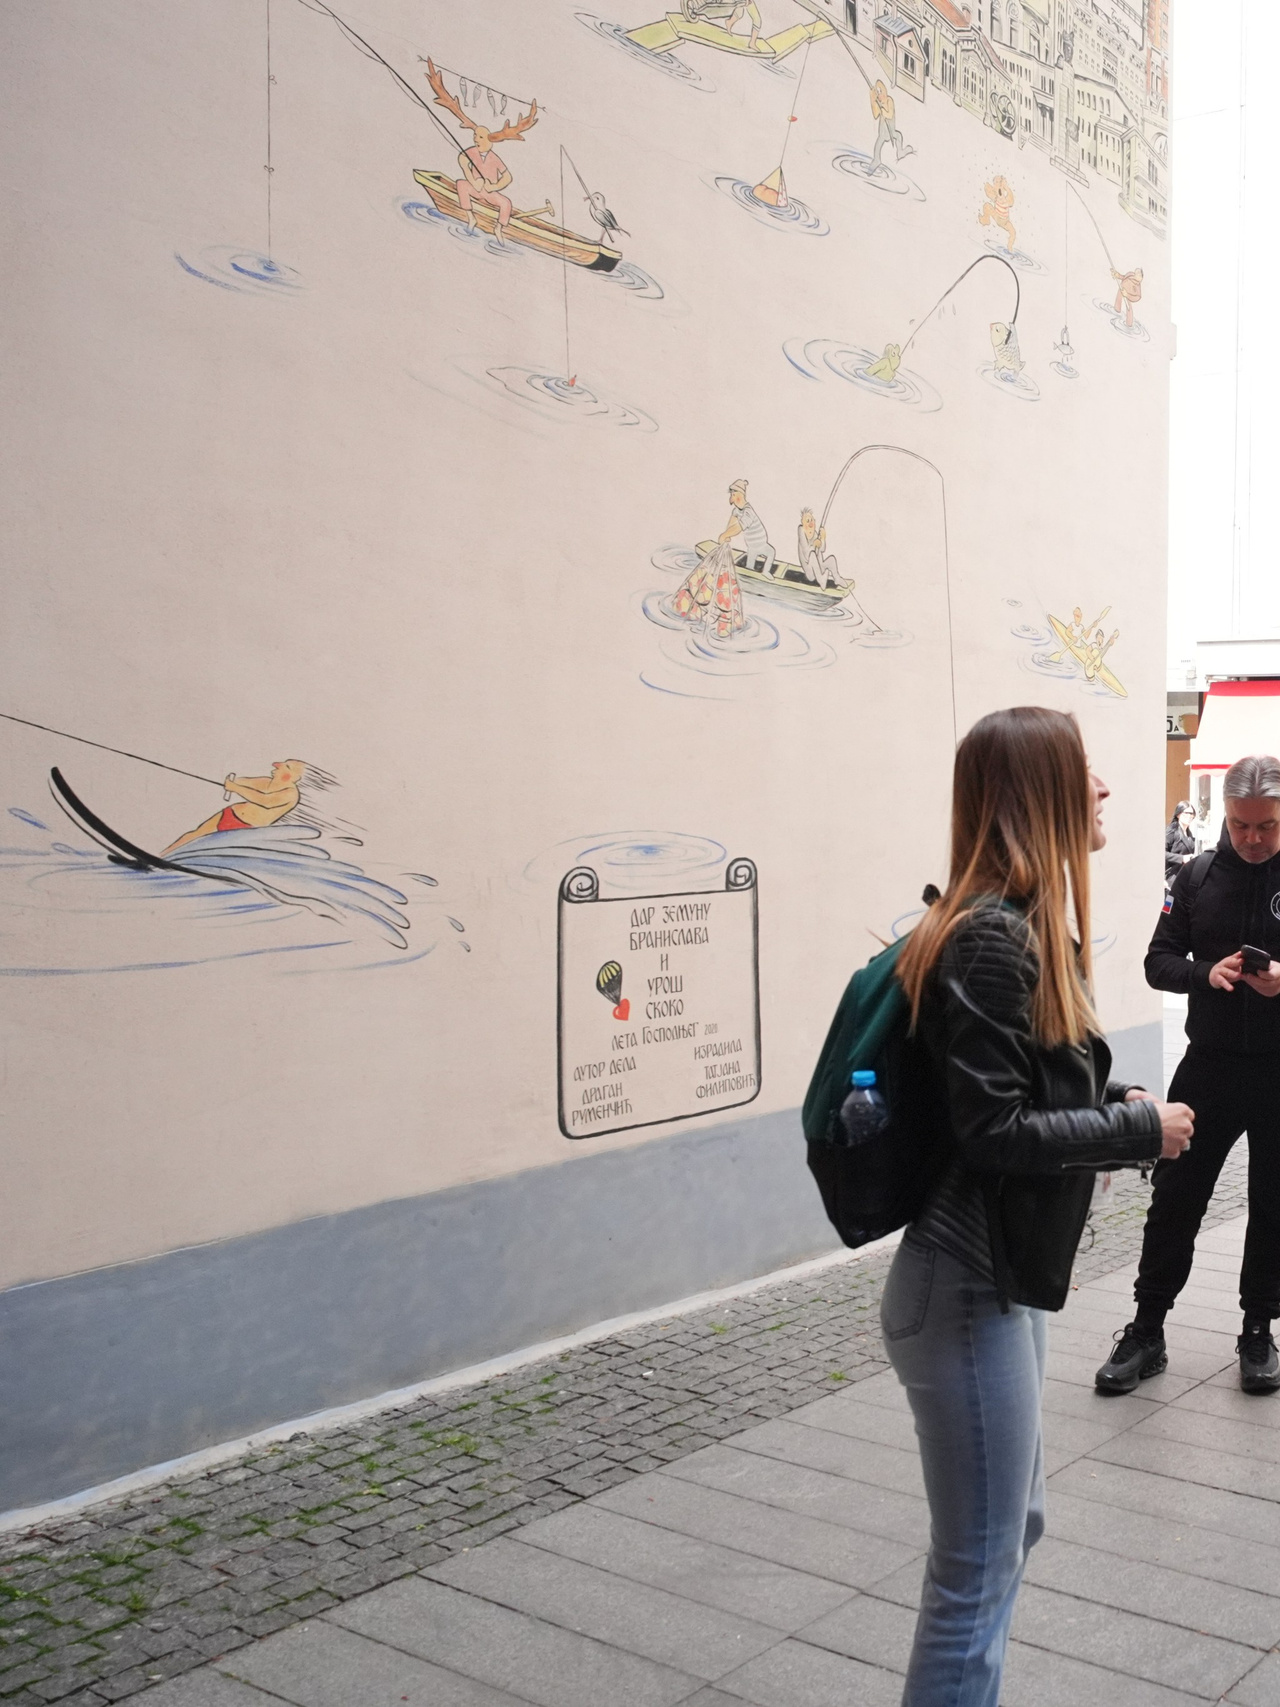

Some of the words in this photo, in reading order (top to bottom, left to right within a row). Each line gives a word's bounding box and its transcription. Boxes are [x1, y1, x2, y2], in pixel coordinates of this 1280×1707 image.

[631, 907, 655, 928] ДАР
[662, 902, 711, 924] ЗЕМУНУ
[630, 926, 709, 951] БРАНИСЛАВА
[660, 953, 668, 971] И
[647, 975, 683, 997] УРОШ
[646, 998, 684, 1020] СКОКО
[612, 1032, 638, 1051] ЛЕТА
[573, 1061, 606, 1082] АУТОР
[609, 1056, 637, 1076] ДЕЛА
[582, 1082, 623, 1105] ДРАГАН
